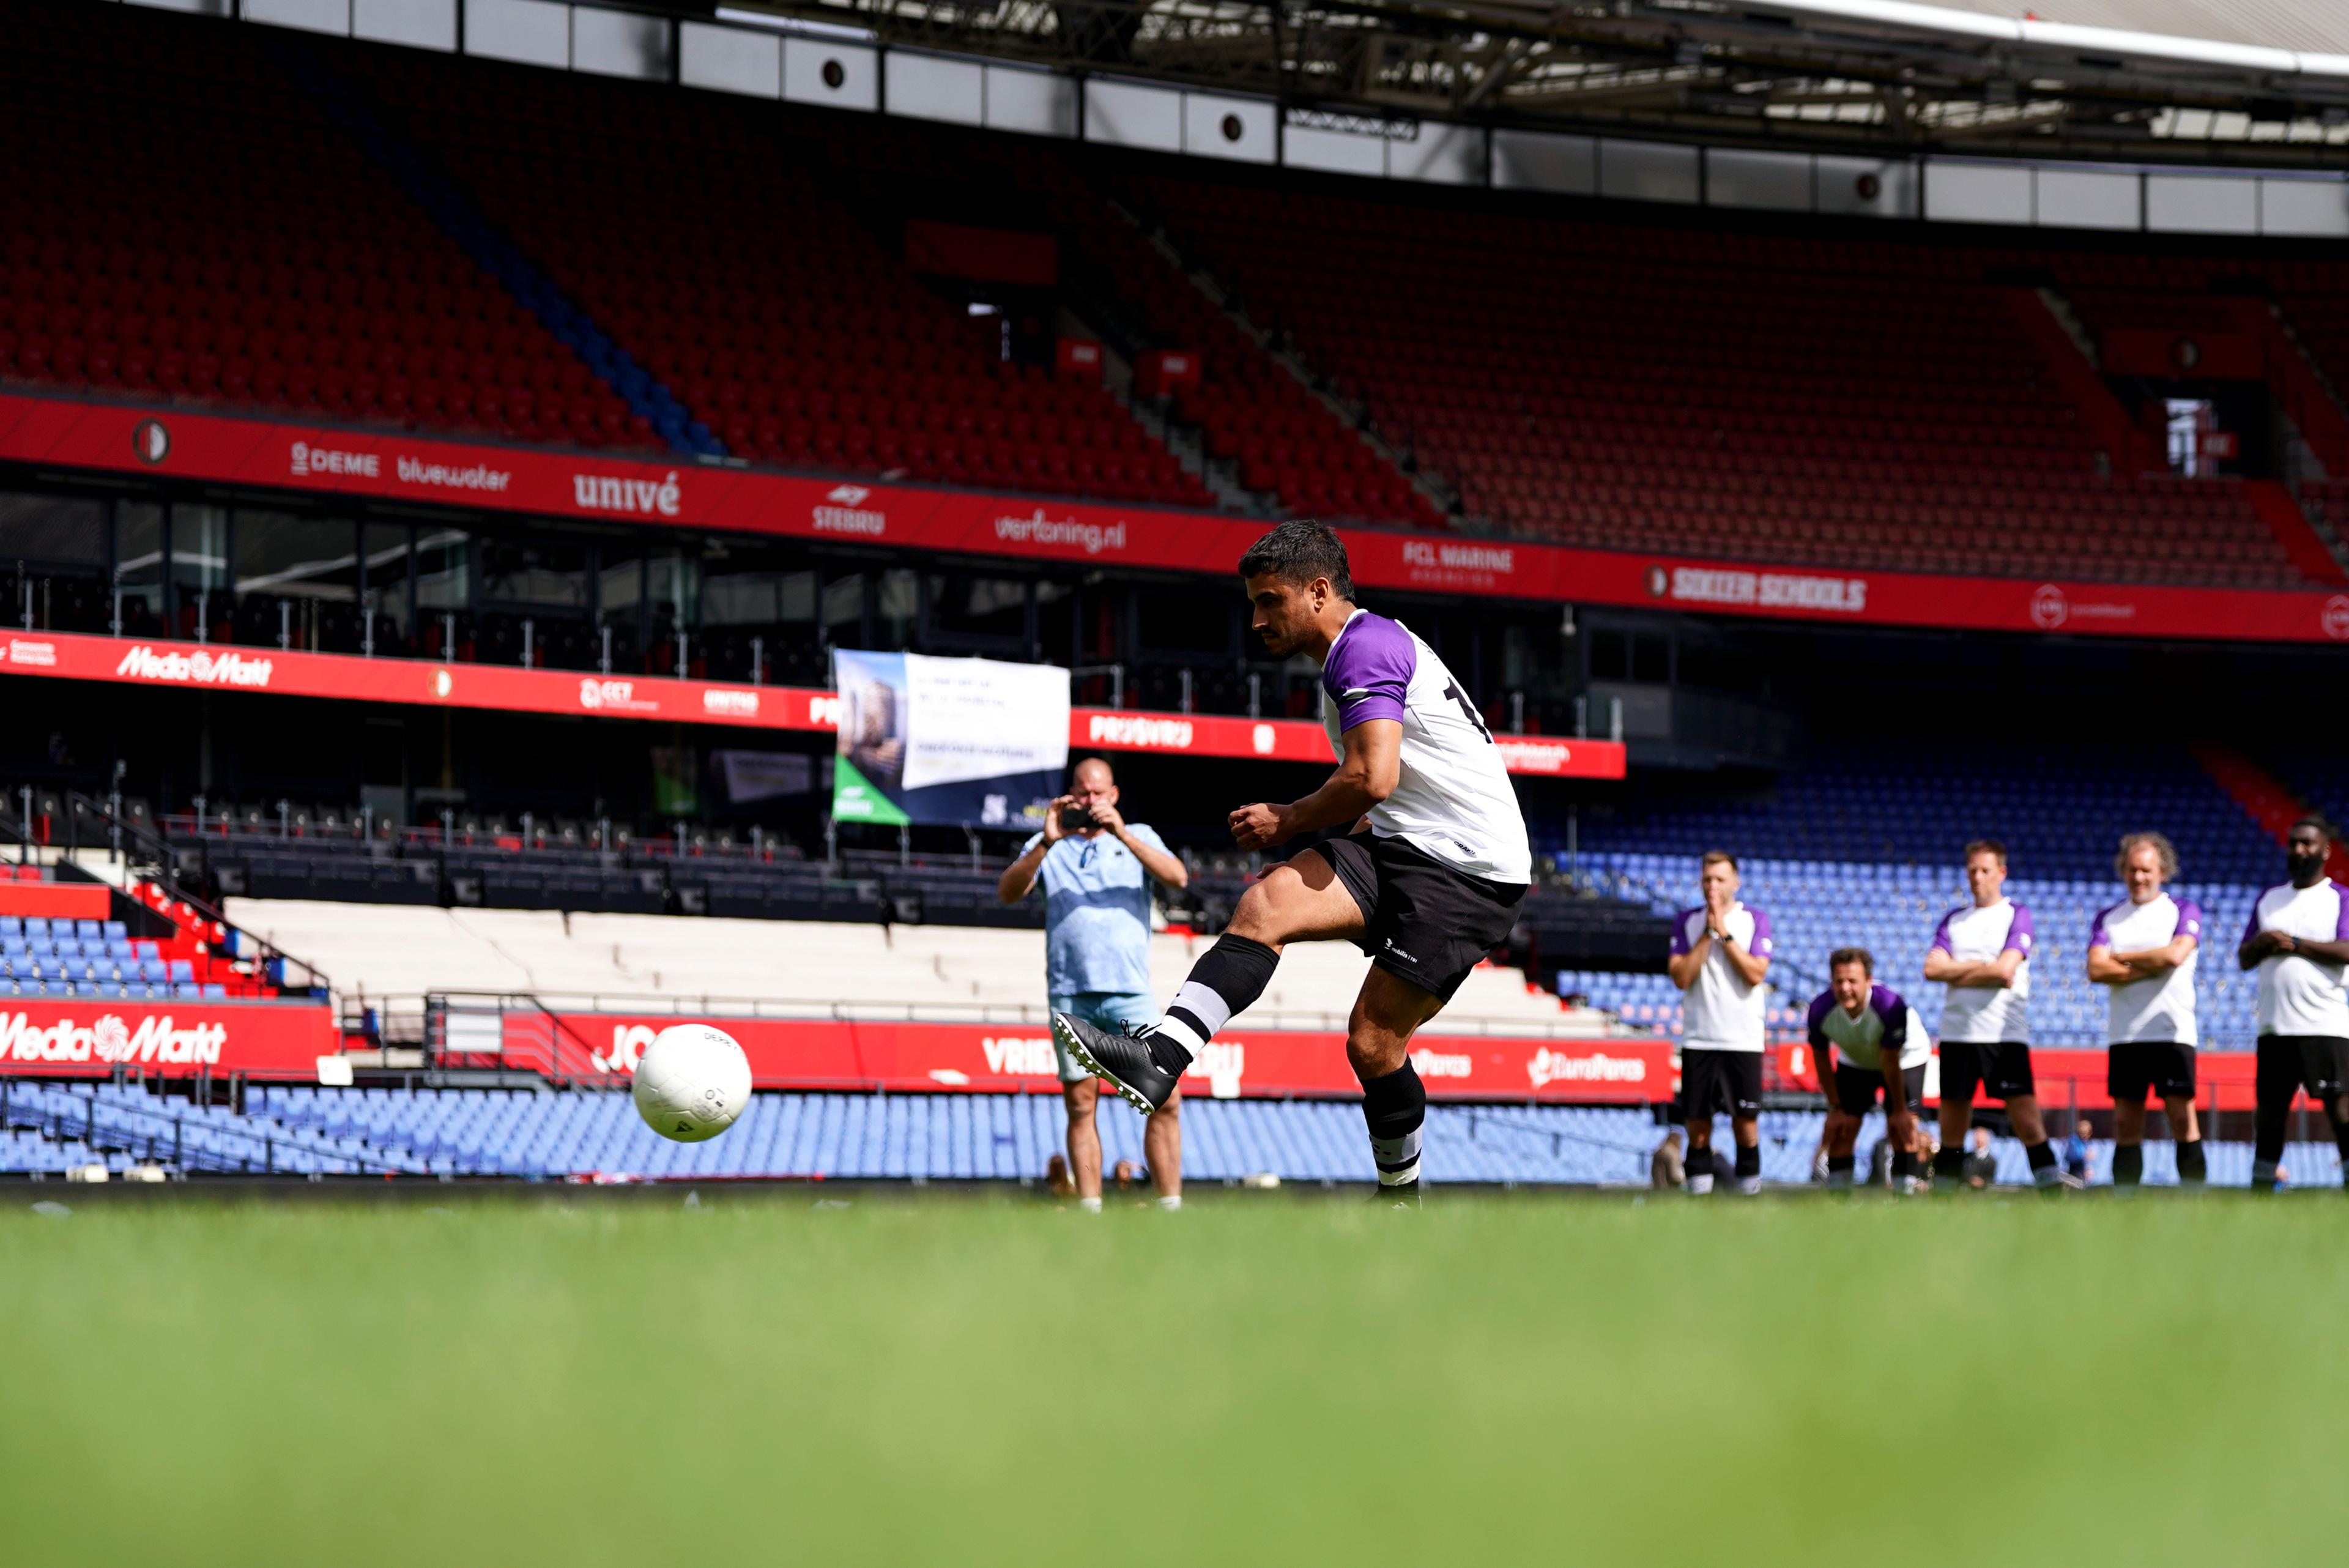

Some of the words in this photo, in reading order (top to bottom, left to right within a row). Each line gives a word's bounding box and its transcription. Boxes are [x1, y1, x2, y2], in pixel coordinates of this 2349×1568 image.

[310, 449, 380, 477] DEME
[398, 456, 510, 492] bluewater
[573, 471, 680, 515] univé
[1403, 541, 1437, 567] FCL
[1439, 544, 1513, 574] MARINE
[1672, 568, 1756, 604] SOCCER
[1758, 574, 1866, 612] SCHOOLS
